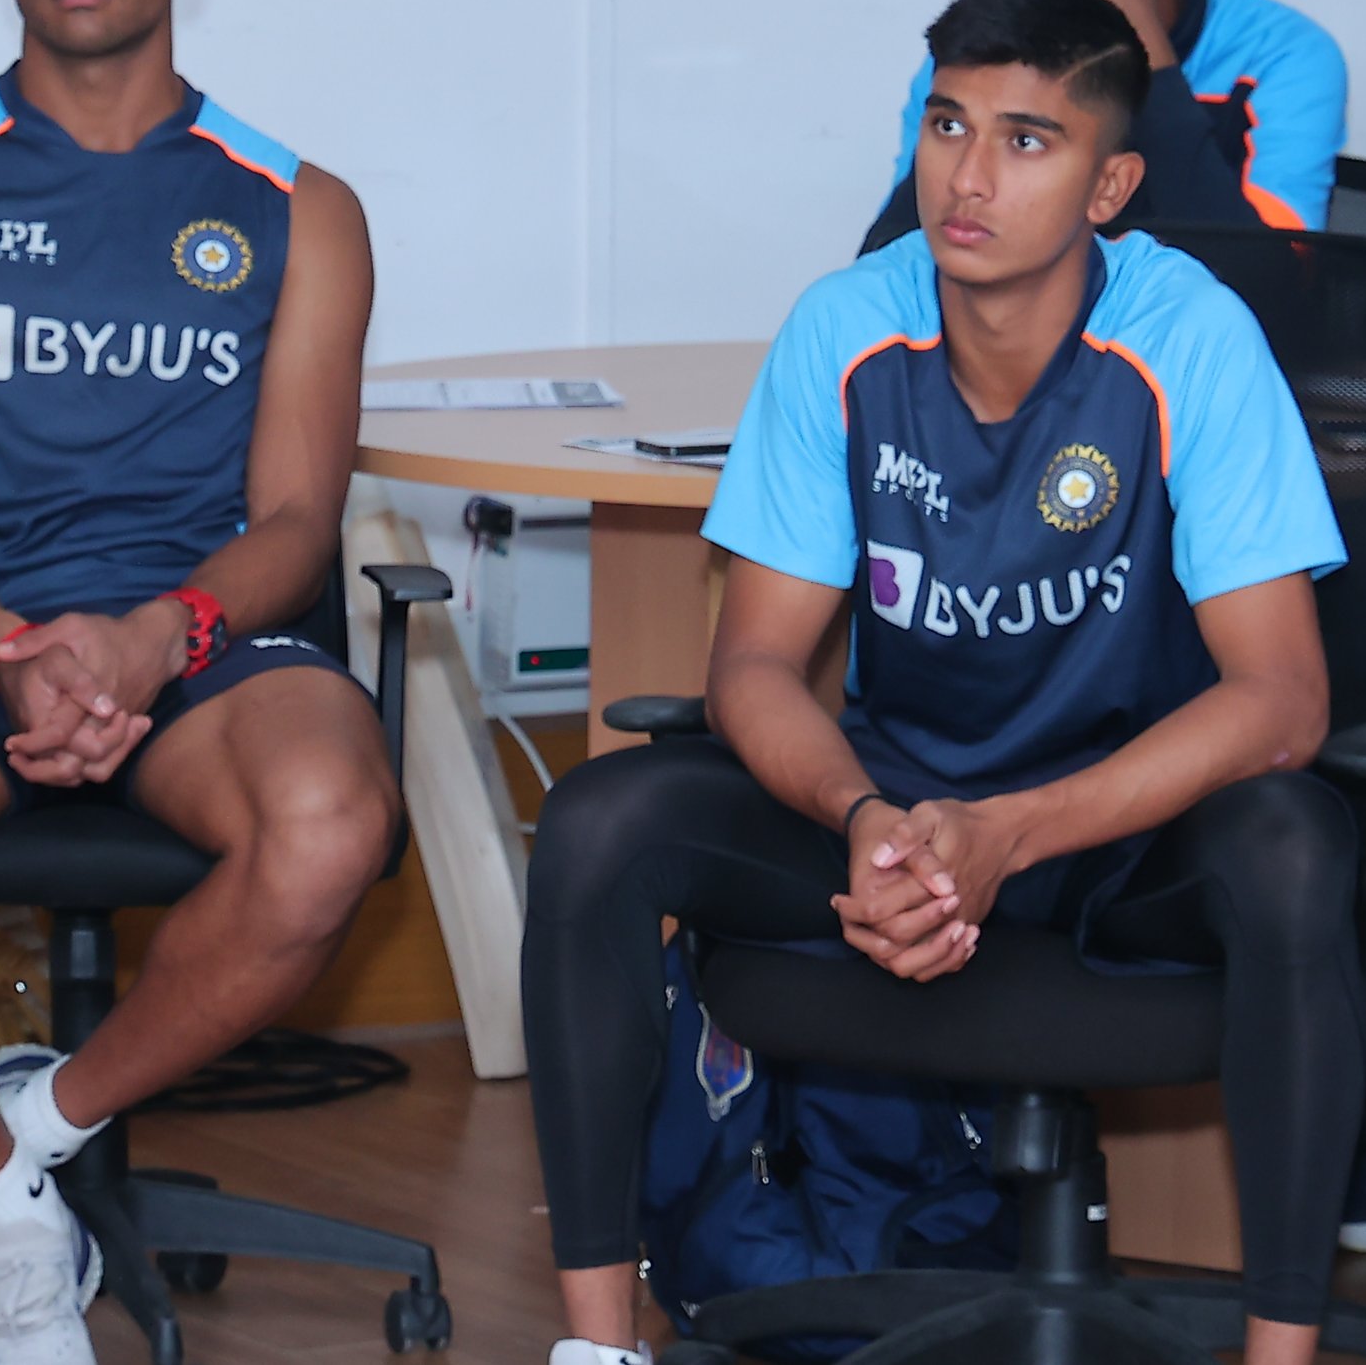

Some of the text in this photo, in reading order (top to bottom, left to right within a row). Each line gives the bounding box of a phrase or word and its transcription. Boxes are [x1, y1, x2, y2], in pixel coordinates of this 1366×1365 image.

[24, 315, 242, 387] BYJU'S
[871, 480, 948, 523] SPOTS
[874, 442, 950, 514] MPL
[923, 552, 1132, 639] BYJU'S
